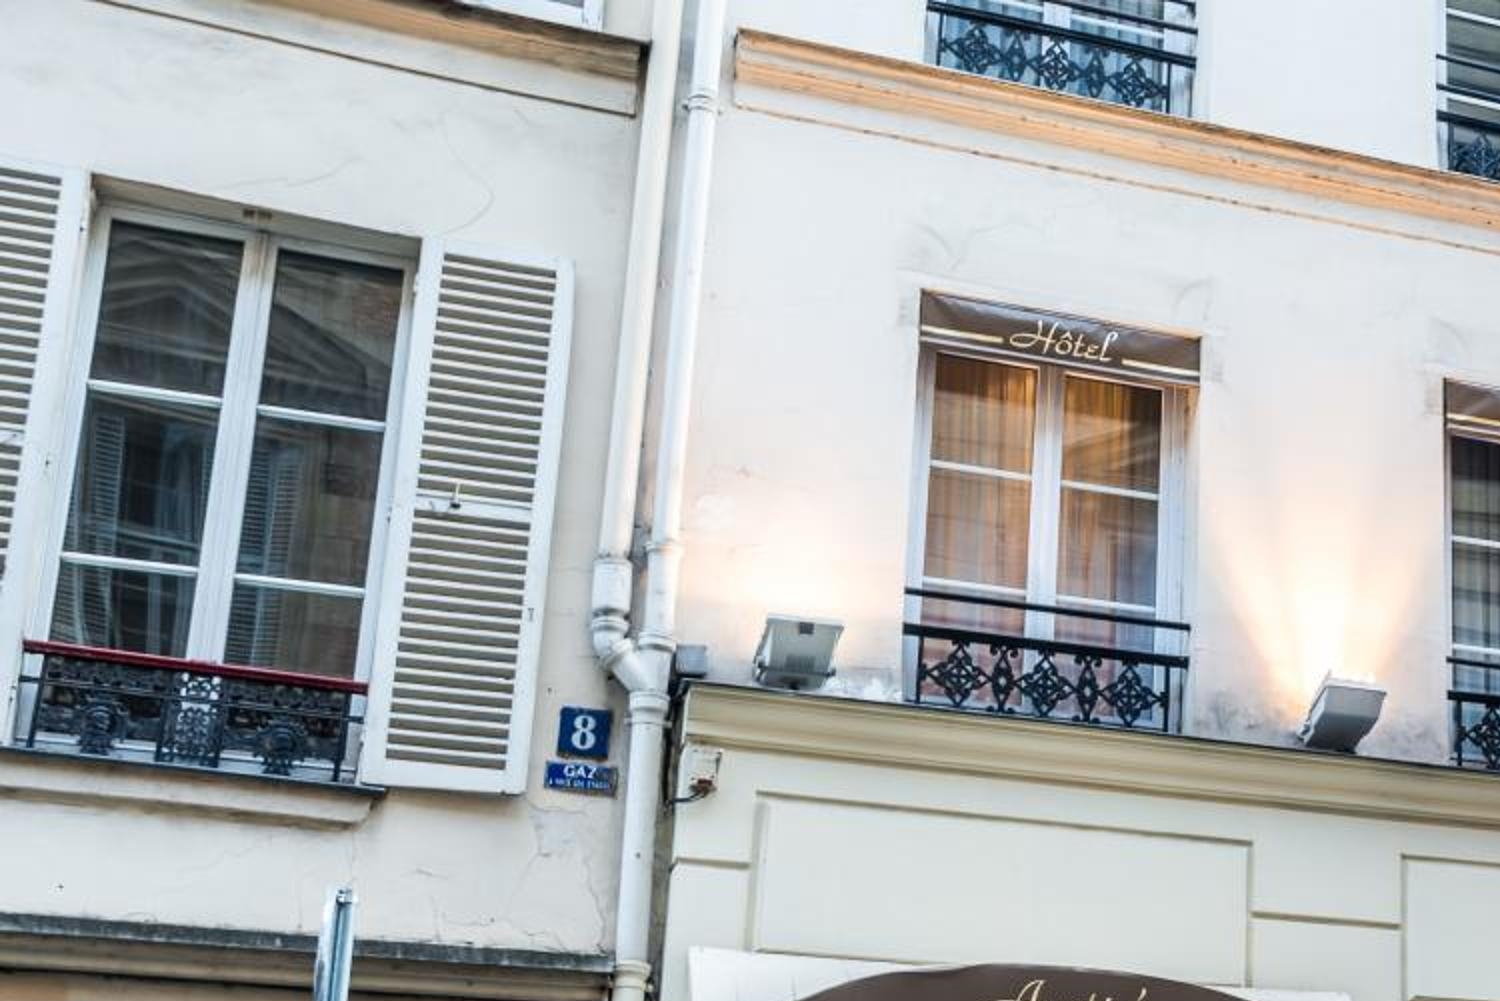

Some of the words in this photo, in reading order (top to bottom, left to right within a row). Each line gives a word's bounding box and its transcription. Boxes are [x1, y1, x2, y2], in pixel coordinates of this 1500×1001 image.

[1009, 319, 1119, 362] Hôtel
[570, 714, 597, 750] 8
[563, 764, 597, 780] GAZ
